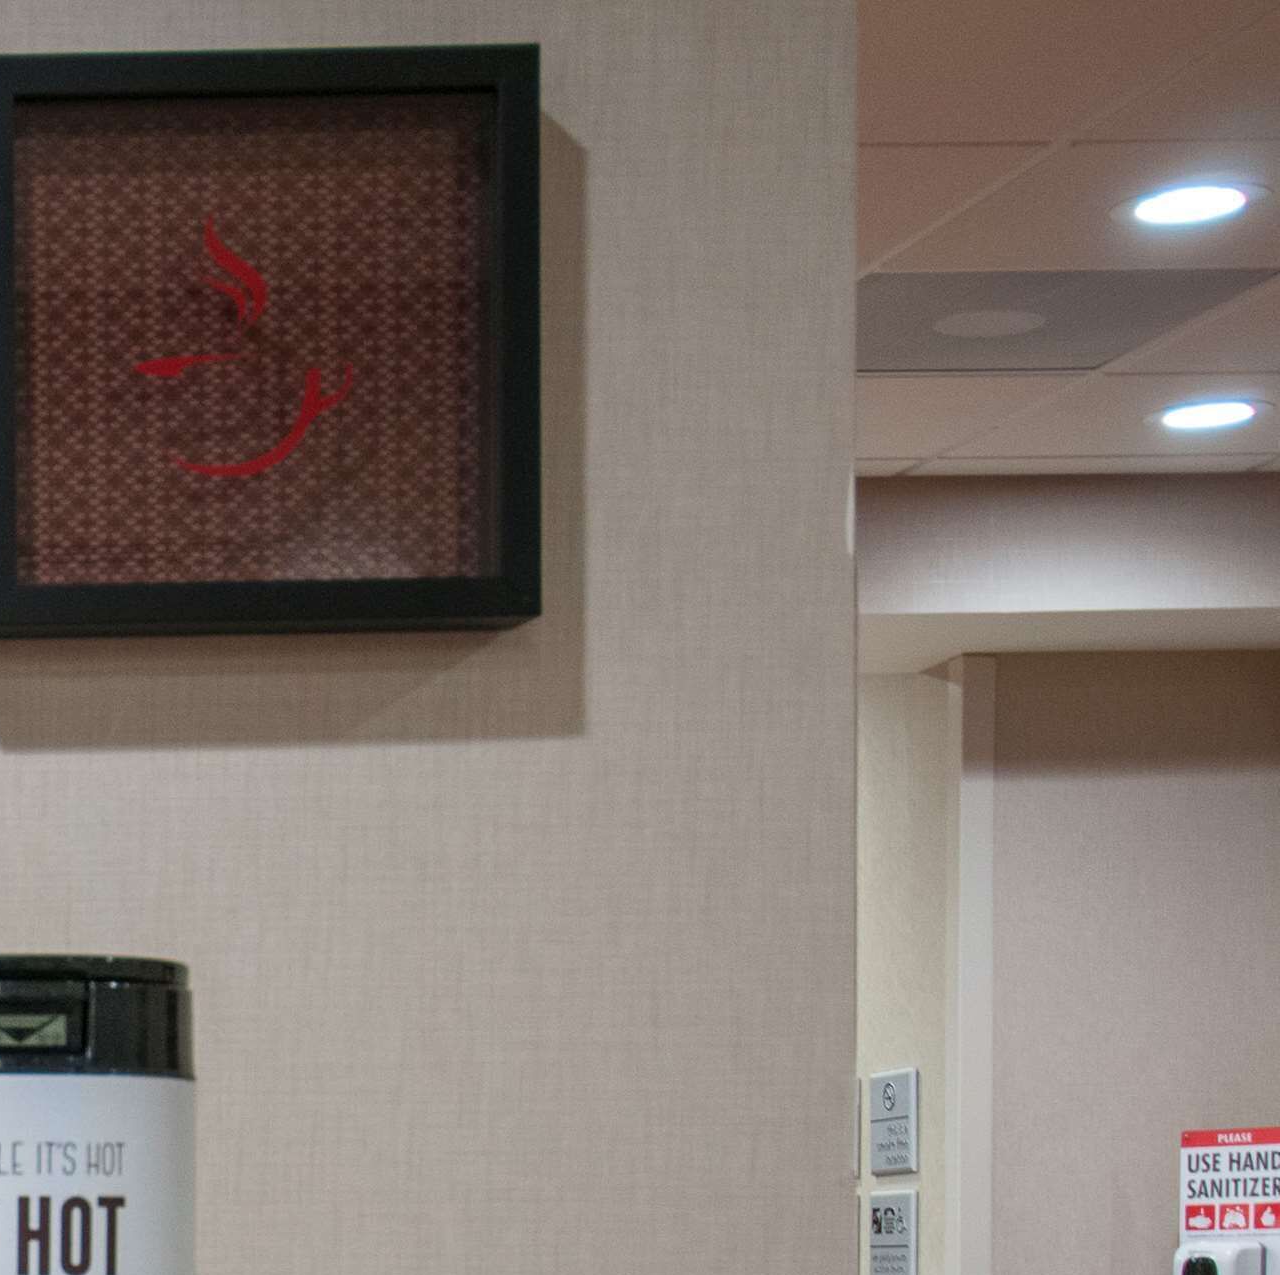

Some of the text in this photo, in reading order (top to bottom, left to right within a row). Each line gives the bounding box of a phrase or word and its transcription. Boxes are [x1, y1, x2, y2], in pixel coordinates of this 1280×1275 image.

[1217, 1132, 1253, 1143] PLEASE
[35, 1141, 77, 1177] IT'S
[87, 1141, 126, 1177] HOT
[1187, 1150, 1280, 1173] USE HAND
